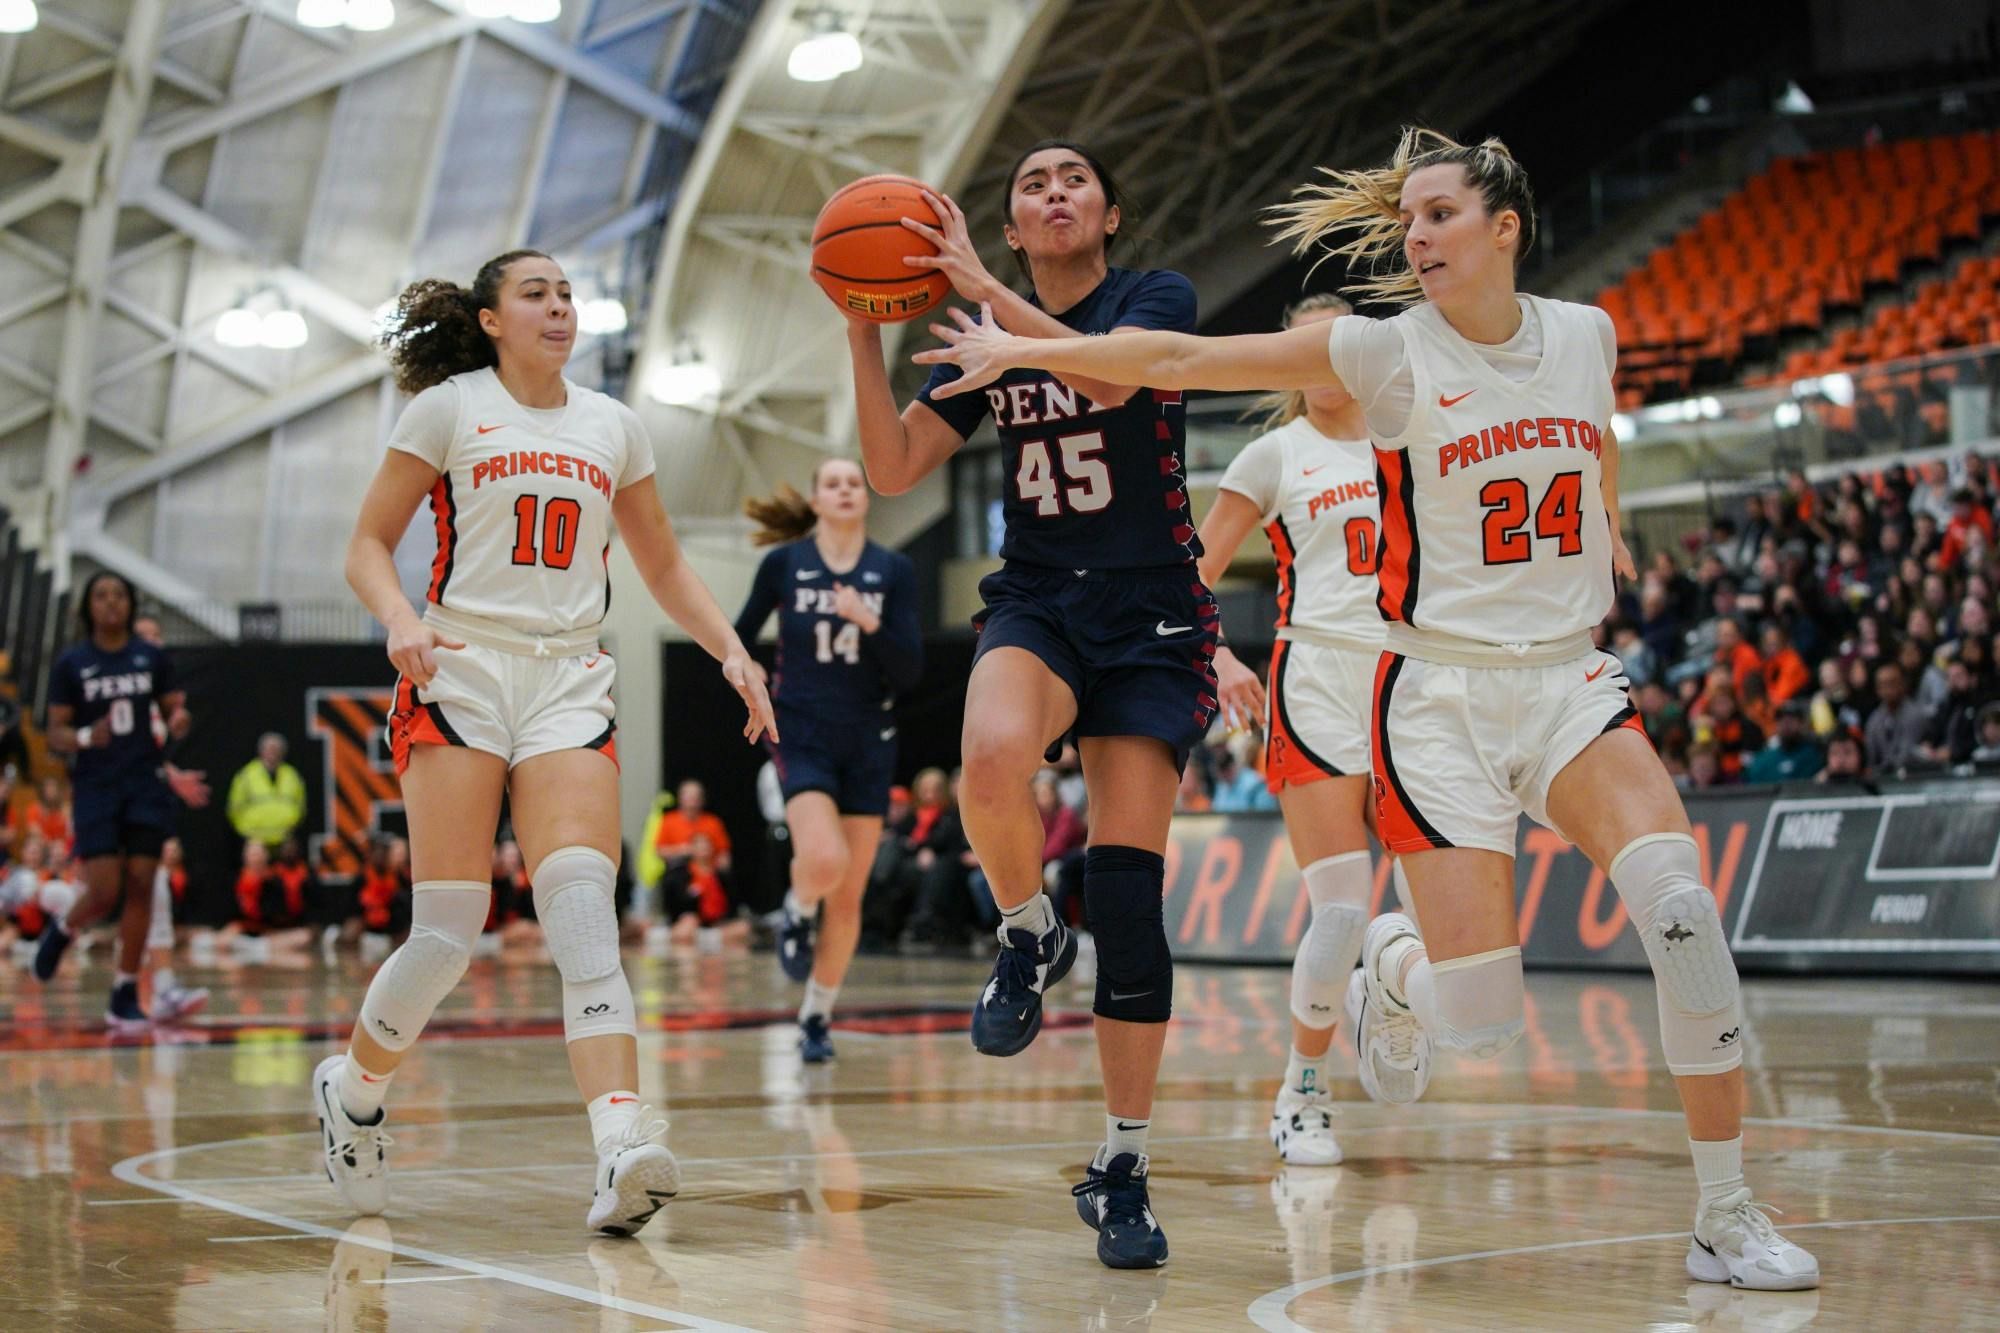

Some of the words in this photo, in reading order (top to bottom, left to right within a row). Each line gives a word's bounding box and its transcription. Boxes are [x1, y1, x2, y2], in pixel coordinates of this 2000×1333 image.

[847, 291, 929, 314] ELITE
[985, 380, 1126, 430] PEN
[1438, 417, 1602, 478] PRINCETON
[473, 450, 612, 503] PRINCETON
[1016, 428, 1117, 518] 45
[511, 493, 583, 571] 10
[1479, 470, 1583, 566] 24
[1344, 516, 1377, 577] 0
[795, 587, 884, 615] PEN
[814, 620, 860, 665] 14
[83, 671, 152, 702] PENN
[110, 698, 135, 736] 0
[1777, 811, 1844, 850] HOME
[1870, 894, 1928, 924] PERIOD
